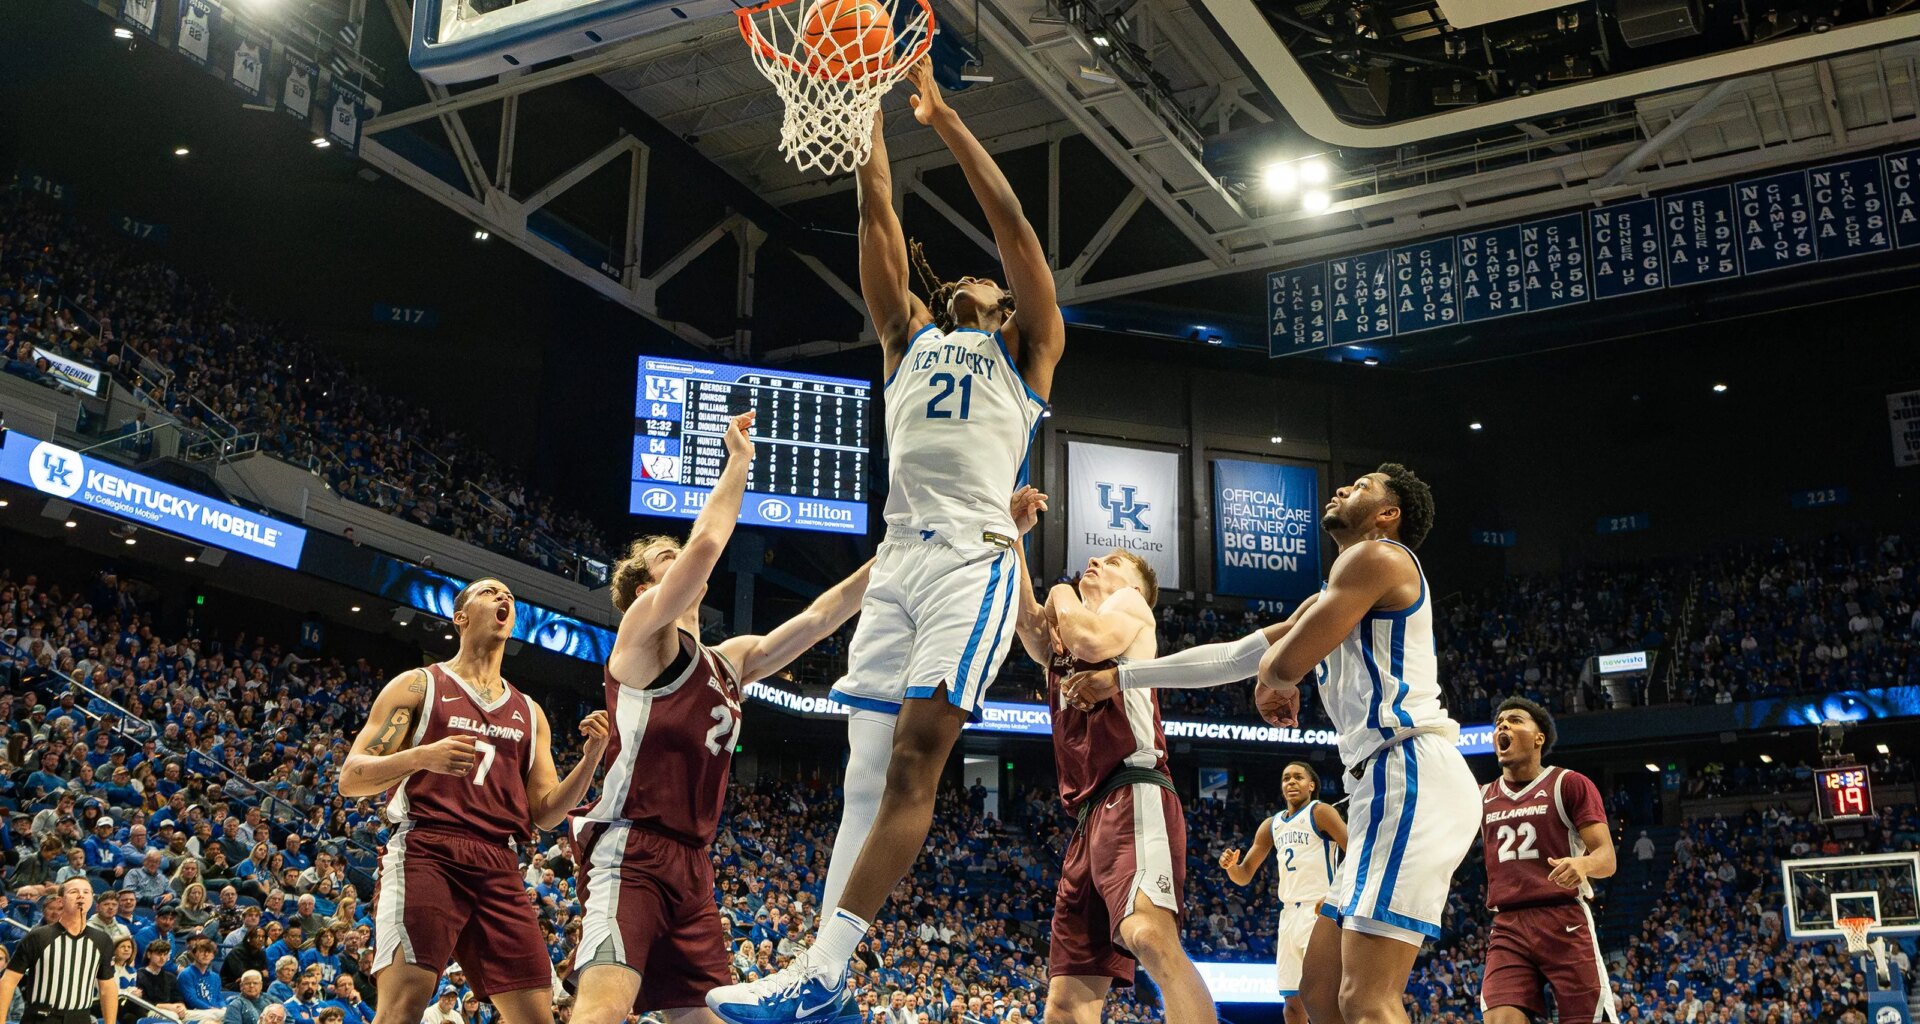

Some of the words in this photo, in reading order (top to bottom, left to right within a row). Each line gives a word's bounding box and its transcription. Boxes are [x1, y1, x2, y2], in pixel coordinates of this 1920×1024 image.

[33, 176, 62, 198] 215
[1840, 172, 1857, 210] FINAL
[1890, 157, 1917, 223] NCAA
[1741, 186, 1766, 250] NCAA
[1812, 172, 1836, 237] NCAA
[1864, 182, 1887, 245] 1984
[122, 216, 153, 238] 217
[1667, 200, 1688, 264] NCAA
[1692, 200, 1708, 248] RUNNER
[1766, 184, 1789, 260] CHAMPION
[1791, 193, 1812, 257] 1978
[1845, 215, 1861, 247] FOUR
[1594, 213, 1614, 276] NCAA
[1618, 213, 1633, 261] RUNNER
[1714, 210, 1733, 273] 1975
[1462, 237, 1481, 299] NCAA
[1523, 227, 1542, 289] NCAA
[1546, 226, 1563, 300] CHAMPION
[1567, 237, 1585, 298] 1958
[1642, 224, 1659, 286] 1966
[1697, 256, 1709, 273] UP
[1396, 252, 1414, 312] NCAA
[1420, 250, 1436, 322] CHAMPION
[1485, 237, 1501, 310] CHAMPION
[1506, 249, 1522, 308] 1951
[1622, 268, 1635, 285] UP
[1292, 276, 1307, 310] FINAL
[1332, 262, 1348, 322] NCAA
[1354, 262, 1369, 333] CHAMPION
[1438, 262, 1455, 320] 1949
[391, 307, 424, 323] 217
[1271, 277, 1287, 335] NCAA
[1310, 285, 1325, 343] 1942
[1293, 316, 1306, 344] FOUR
[63, 365, 95, 383] RENTAL
[911, 344, 996, 381] KENTUCKY
[652, 378, 678, 400] UK
[690, 382, 694, 390] 1
[700, 383, 731, 393] ABERDEEN
[750, 388, 758, 396] 11
[772, 391, 779, 399] 2
[794, 393, 800, 401] 2
[815, 395, 822, 403] 0
[836, 398, 842, 406] 0
[856, 400, 862, 408] 2
[749, 377, 760, 385] PTS
[770, 379, 782, 387] REB
[792, 381, 803, 389] AST
[813, 384, 824, 392] BLK
[834, 387, 845, 395] STL
[854, 389, 865, 397] FLS
[926, 372, 973, 420] 21
[651, 403, 668, 418] 64
[686, 412, 694, 420] 21
[698, 412, 732, 422] QUAINTANC
[688, 392, 693, 400] 2
[699, 393, 726, 402] JOHNSON
[750, 398, 758, 406] 11
[772, 400, 778, 408] 2
[816, 405, 821, 413] 1
[836, 407, 842, 415] 0
[857, 410, 862, 418] 1
[688, 402, 693, 410] 3
[698, 403, 728, 412] WILLIAMS
[646, 419, 672, 431] 12:32
[686, 421, 694, 430] 23
[771, 430, 777, 438] 2
[792, 432, 799, 440] 0
[814, 434, 820, 442] 2
[836, 437, 841, 445] 1
[856, 439, 861, 447] 1
[649, 438, 666, 453] 54
[684, 446, 692, 454] 11
[696, 447, 725, 457] WADDELL
[686, 436, 691, 444] 7
[697, 437, 721, 446] HUNTER
[771, 444, 776, 452] 1
[792, 447, 798, 455] 0
[814, 449, 820, 457] 0
[835, 451, 840, 459] 1
[855, 453, 861, 461] 3
[42, 452, 74, 488] UK
[683, 466, 692, 474] 23
[695, 467, 720, 476] DONALD
[748, 472, 754, 480] 0
[770, 474, 775, 482] 1
[791, 476, 797, 484] 1
[813, 478, 819, 486] 0
[834, 480, 840, 488] 0
[854, 483, 861, 491] 2
[684, 456, 692, 464] 22
[696, 457, 720, 467] BOLDEN
[748, 462, 754, 470] 0
[770, 464, 776, 472] 0
[791, 467, 798, 475] 2
[813, 468, 819, 476] 0
[834, 471, 840, 479] 3
[855, 473, 860, 481] 1
[84, 491, 95, 503] By
[95, 495, 134, 513] Collegiate
[87, 469, 199, 521] KENTUCKY
[682, 476, 692, 484] 24
[746, 482, 755, 490] 11
[769, 484, 775, 492] 2
[790, 486, 797, 494] 0
[813, 488, 819, 496] 0
[834, 490, 839, 498] 1
[854, 492, 860, 500] 0
[1222, 488, 1283, 506] OFFICIAL
[798, 502, 852, 521] Hilton
[1095, 481, 1151, 533] UK
[1222, 503, 1312, 523] HEALTHCARE
[1223, 517, 1284, 534] PARTNER
[1287, 522, 1307, 536] OF
[1610, 516, 1636, 531] 221
[1084, 532, 1163, 553] HealthCare
[1224, 532, 1258, 550] BIG
[1261, 535, 1307, 555] BLUE
[1225, 550, 1298, 572] NATION
[1258, 600, 1284, 613] 219
[304, 626, 319, 643] 16
[743, 681, 851, 714] NTUCKYMOBILE
[447, 715, 524, 743] BELLARMINE
[472, 740, 496, 786] 7
[1826, 771, 1863, 788] 12:32
[1838, 787, 1863, 813] 19
[1485, 804, 1548, 825] BELLARMINE
[1497, 821, 1539, 863] 22
[1285, 847, 1296, 872] 2
